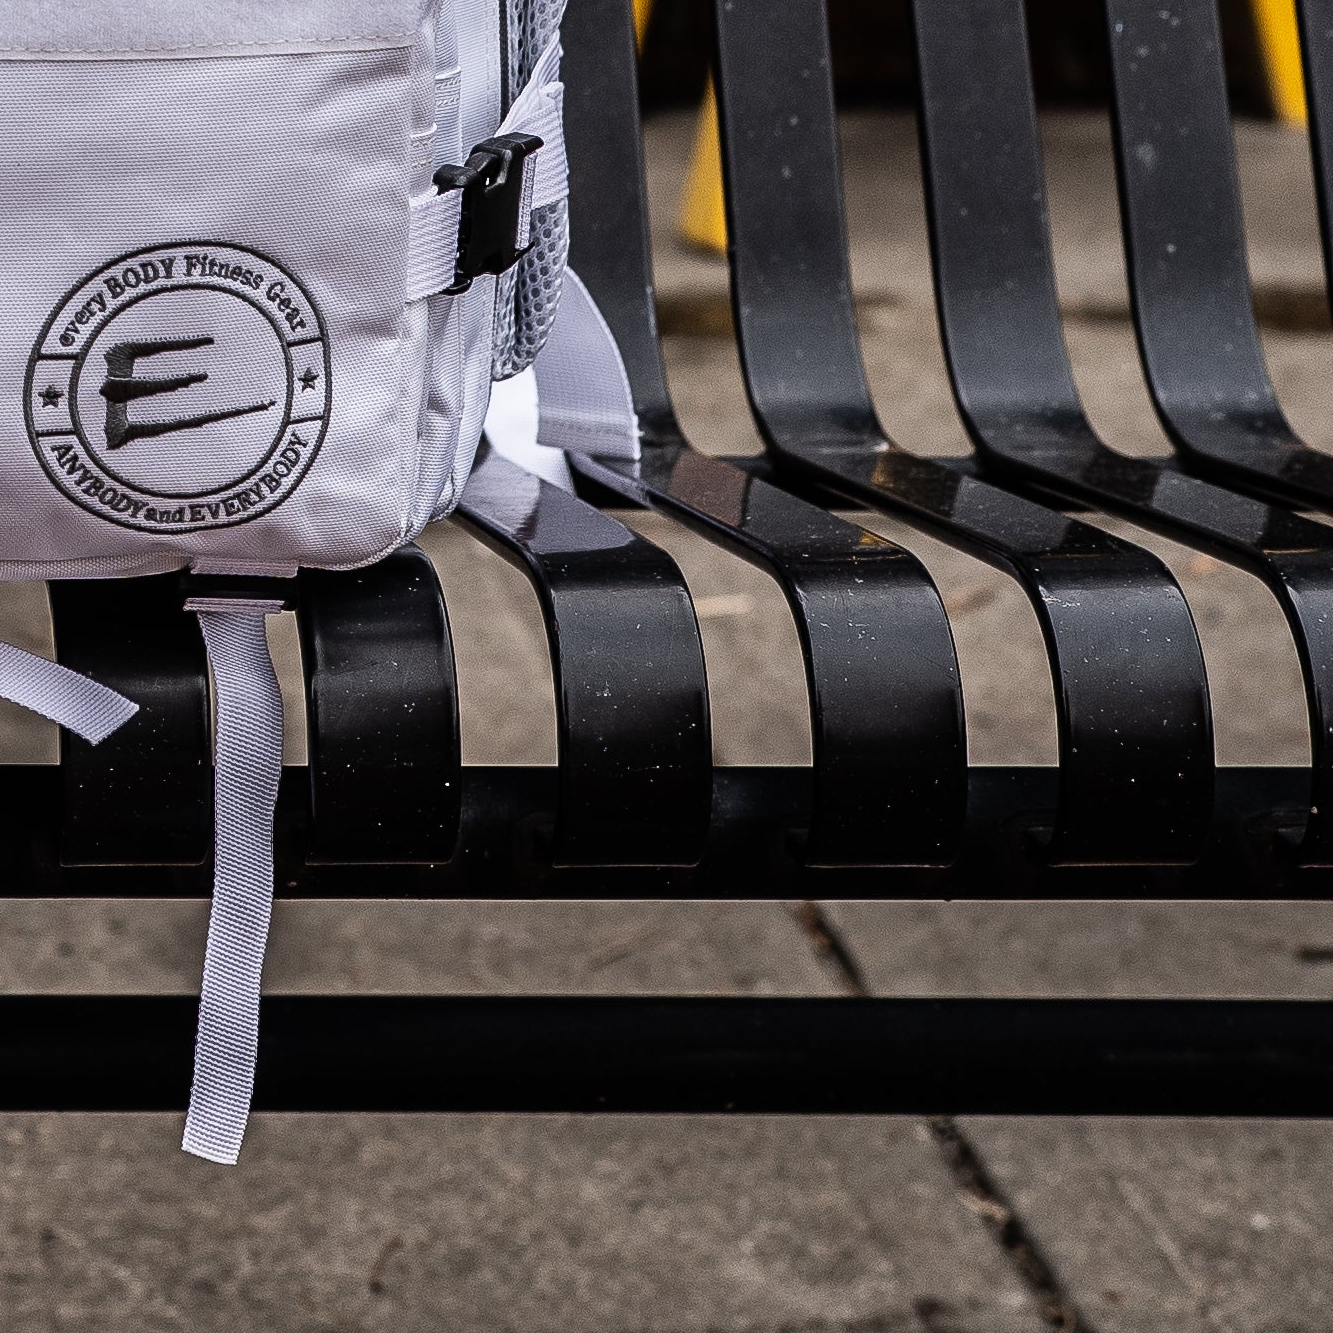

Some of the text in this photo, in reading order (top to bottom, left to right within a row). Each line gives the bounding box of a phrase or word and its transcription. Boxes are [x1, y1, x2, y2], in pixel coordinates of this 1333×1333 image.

[58, 253, 308, 347] every BODY Fitness Gear
[50, 431, 310, 523] ANYBODY and EVERYBODY
